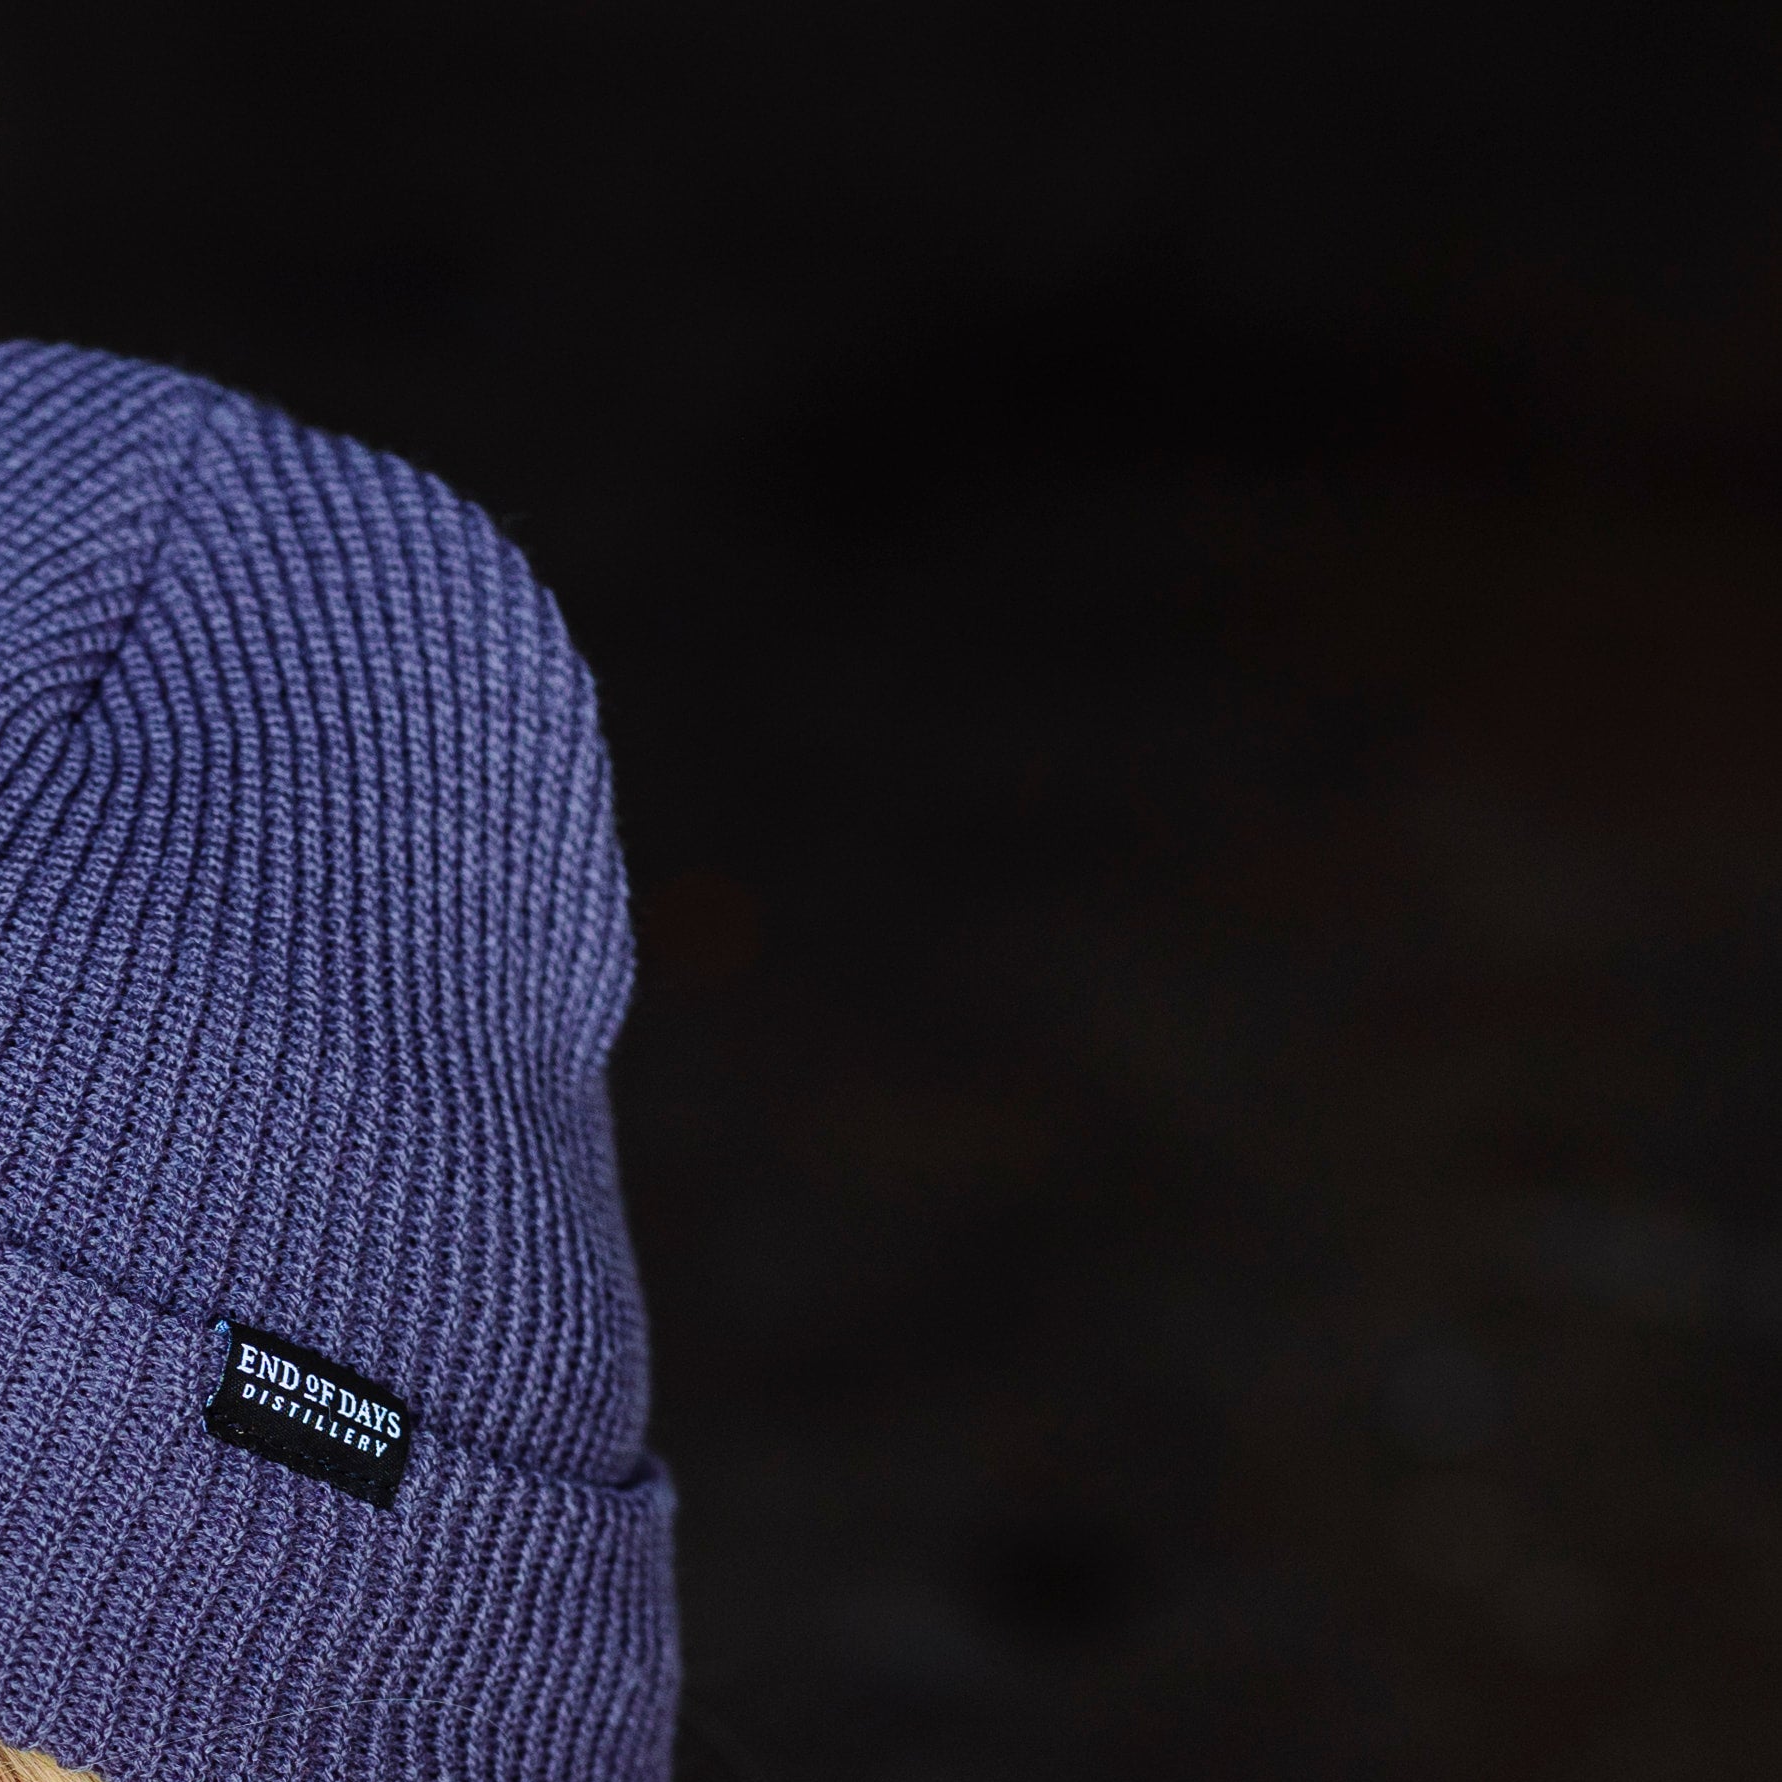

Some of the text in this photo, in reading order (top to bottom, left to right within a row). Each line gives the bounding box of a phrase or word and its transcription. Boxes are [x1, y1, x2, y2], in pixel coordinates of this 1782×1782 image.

[238, 1344, 300, 1390] END
[338, 1389, 401, 1438] DAYS
[243, 1384, 387, 1457] DISTILLERY
